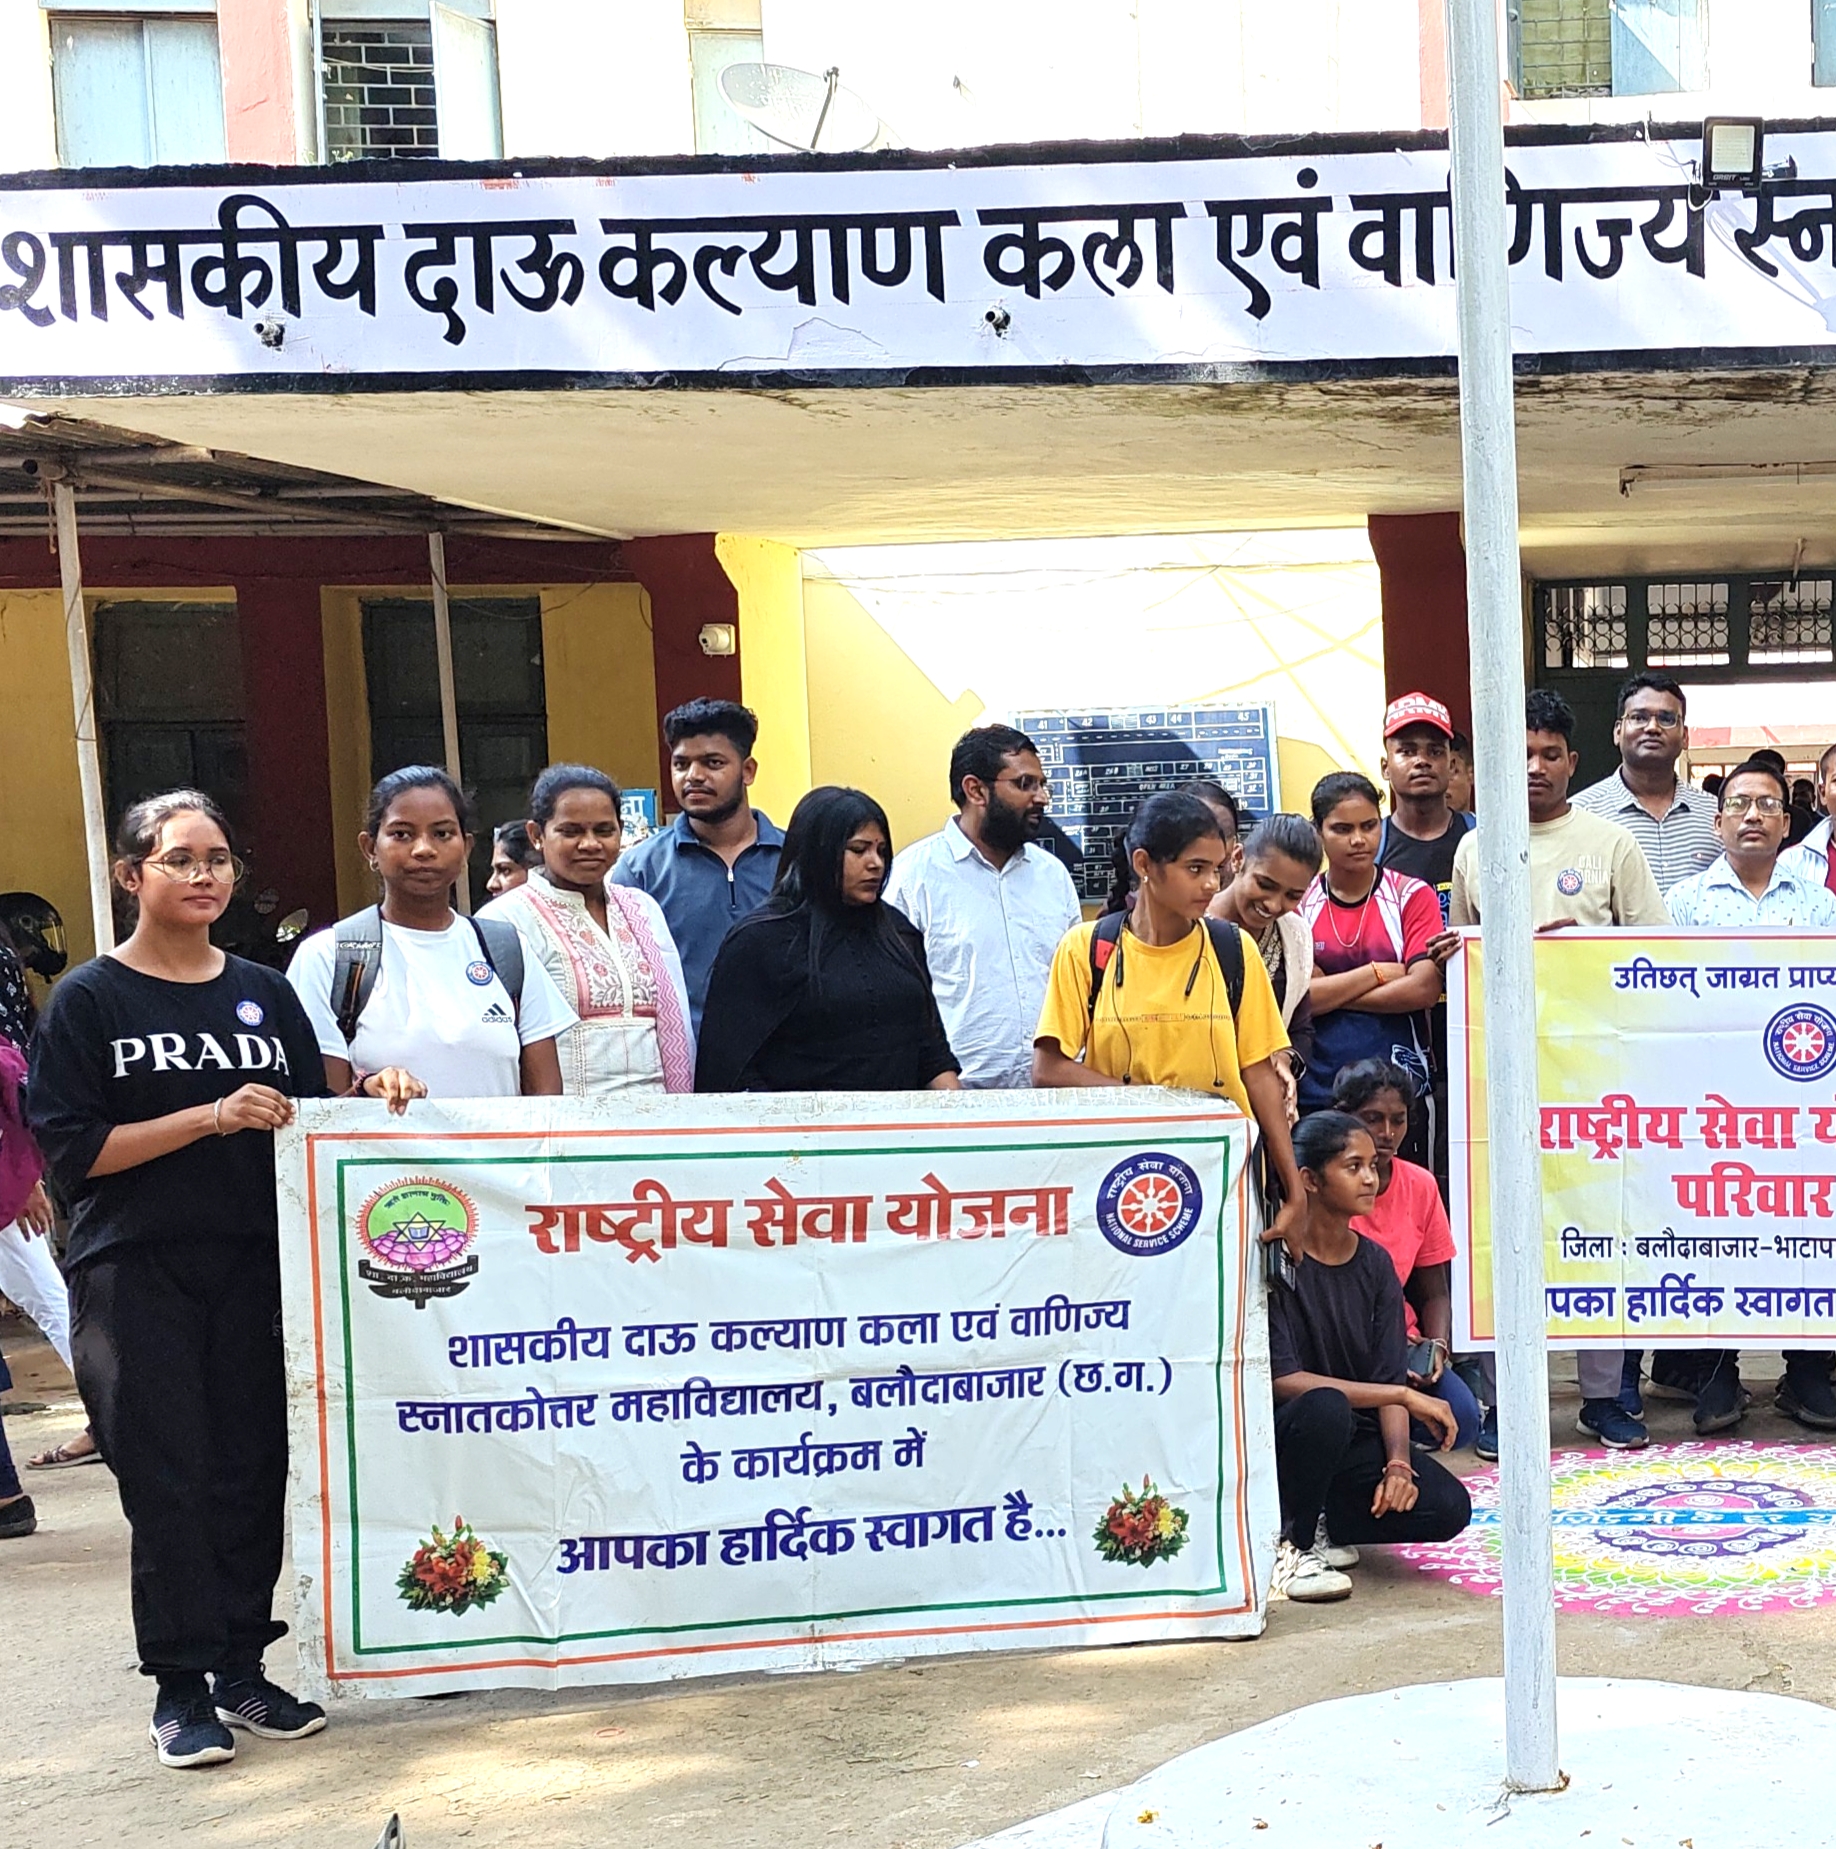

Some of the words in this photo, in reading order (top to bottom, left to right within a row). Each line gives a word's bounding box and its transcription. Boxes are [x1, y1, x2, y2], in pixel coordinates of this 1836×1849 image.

[0, 195, 385, 327] शासकीय
[403, 219, 584, 345] दाऊ
[599, 210, 961, 315] कल्याण
[977, 202, 1187, 299] कला
[1204, 168, 1333, 320] एवं
[1037, 721, 1048, 730] 41
[1082, 718, 1093, 726] 42
[110, 1032, 289, 1078] PRADA
[1697, 1094, 1799, 1149] सेवा
[1672, 1161, 1836, 1218] परिवार
[527, 1178, 732, 1264] राष्ट्रीय
[746, 1177, 872, 1247] सेवा
[886, 1173, 1073, 1240] योजना
[1105, 1212, 1132, 1245] NATIONAL
[1133, 1234, 1169, 1248] SERVICE
[1168, 1207, 1193, 1239] SCHEME
[1561, 1226, 1613, 1259] जिला
[1545, 1287, 1616, 1317] पका
[1625, 1272, 1725, 1323] हार्दिक
[1733, 1287, 1836, 1317] स्वागत
[449, 1317, 611, 1367] शासकीय
[622, 1322, 698, 1357] दाऊ
[709, 1317, 848, 1352] कल्याण
[858, 1312, 940, 1346] कला
[951, 1303, 1000, 1341] एवं
[1009, 1294, 1131, 1337] वाणिज्य
[396, 1386, 598, 1434] स्नातकोत्तर
[610, 1376, 838, 1423] महाविद्यालय,
[849, 1365, 1046, 1409] बलौदाबाजार
[1058, 1357, 1172, 1397] (छ.ग.)
[680, 1440, 721, 1484] के
[732, 1431, 882, 1480] कार्यक्रम
[893, 1427, 927, 1468] में
[557, 1531, 711, 1574] आपका
[718, 1505, 856, 1566] हार्दिक
[863, 1505, 997, 1552] स्वागत
